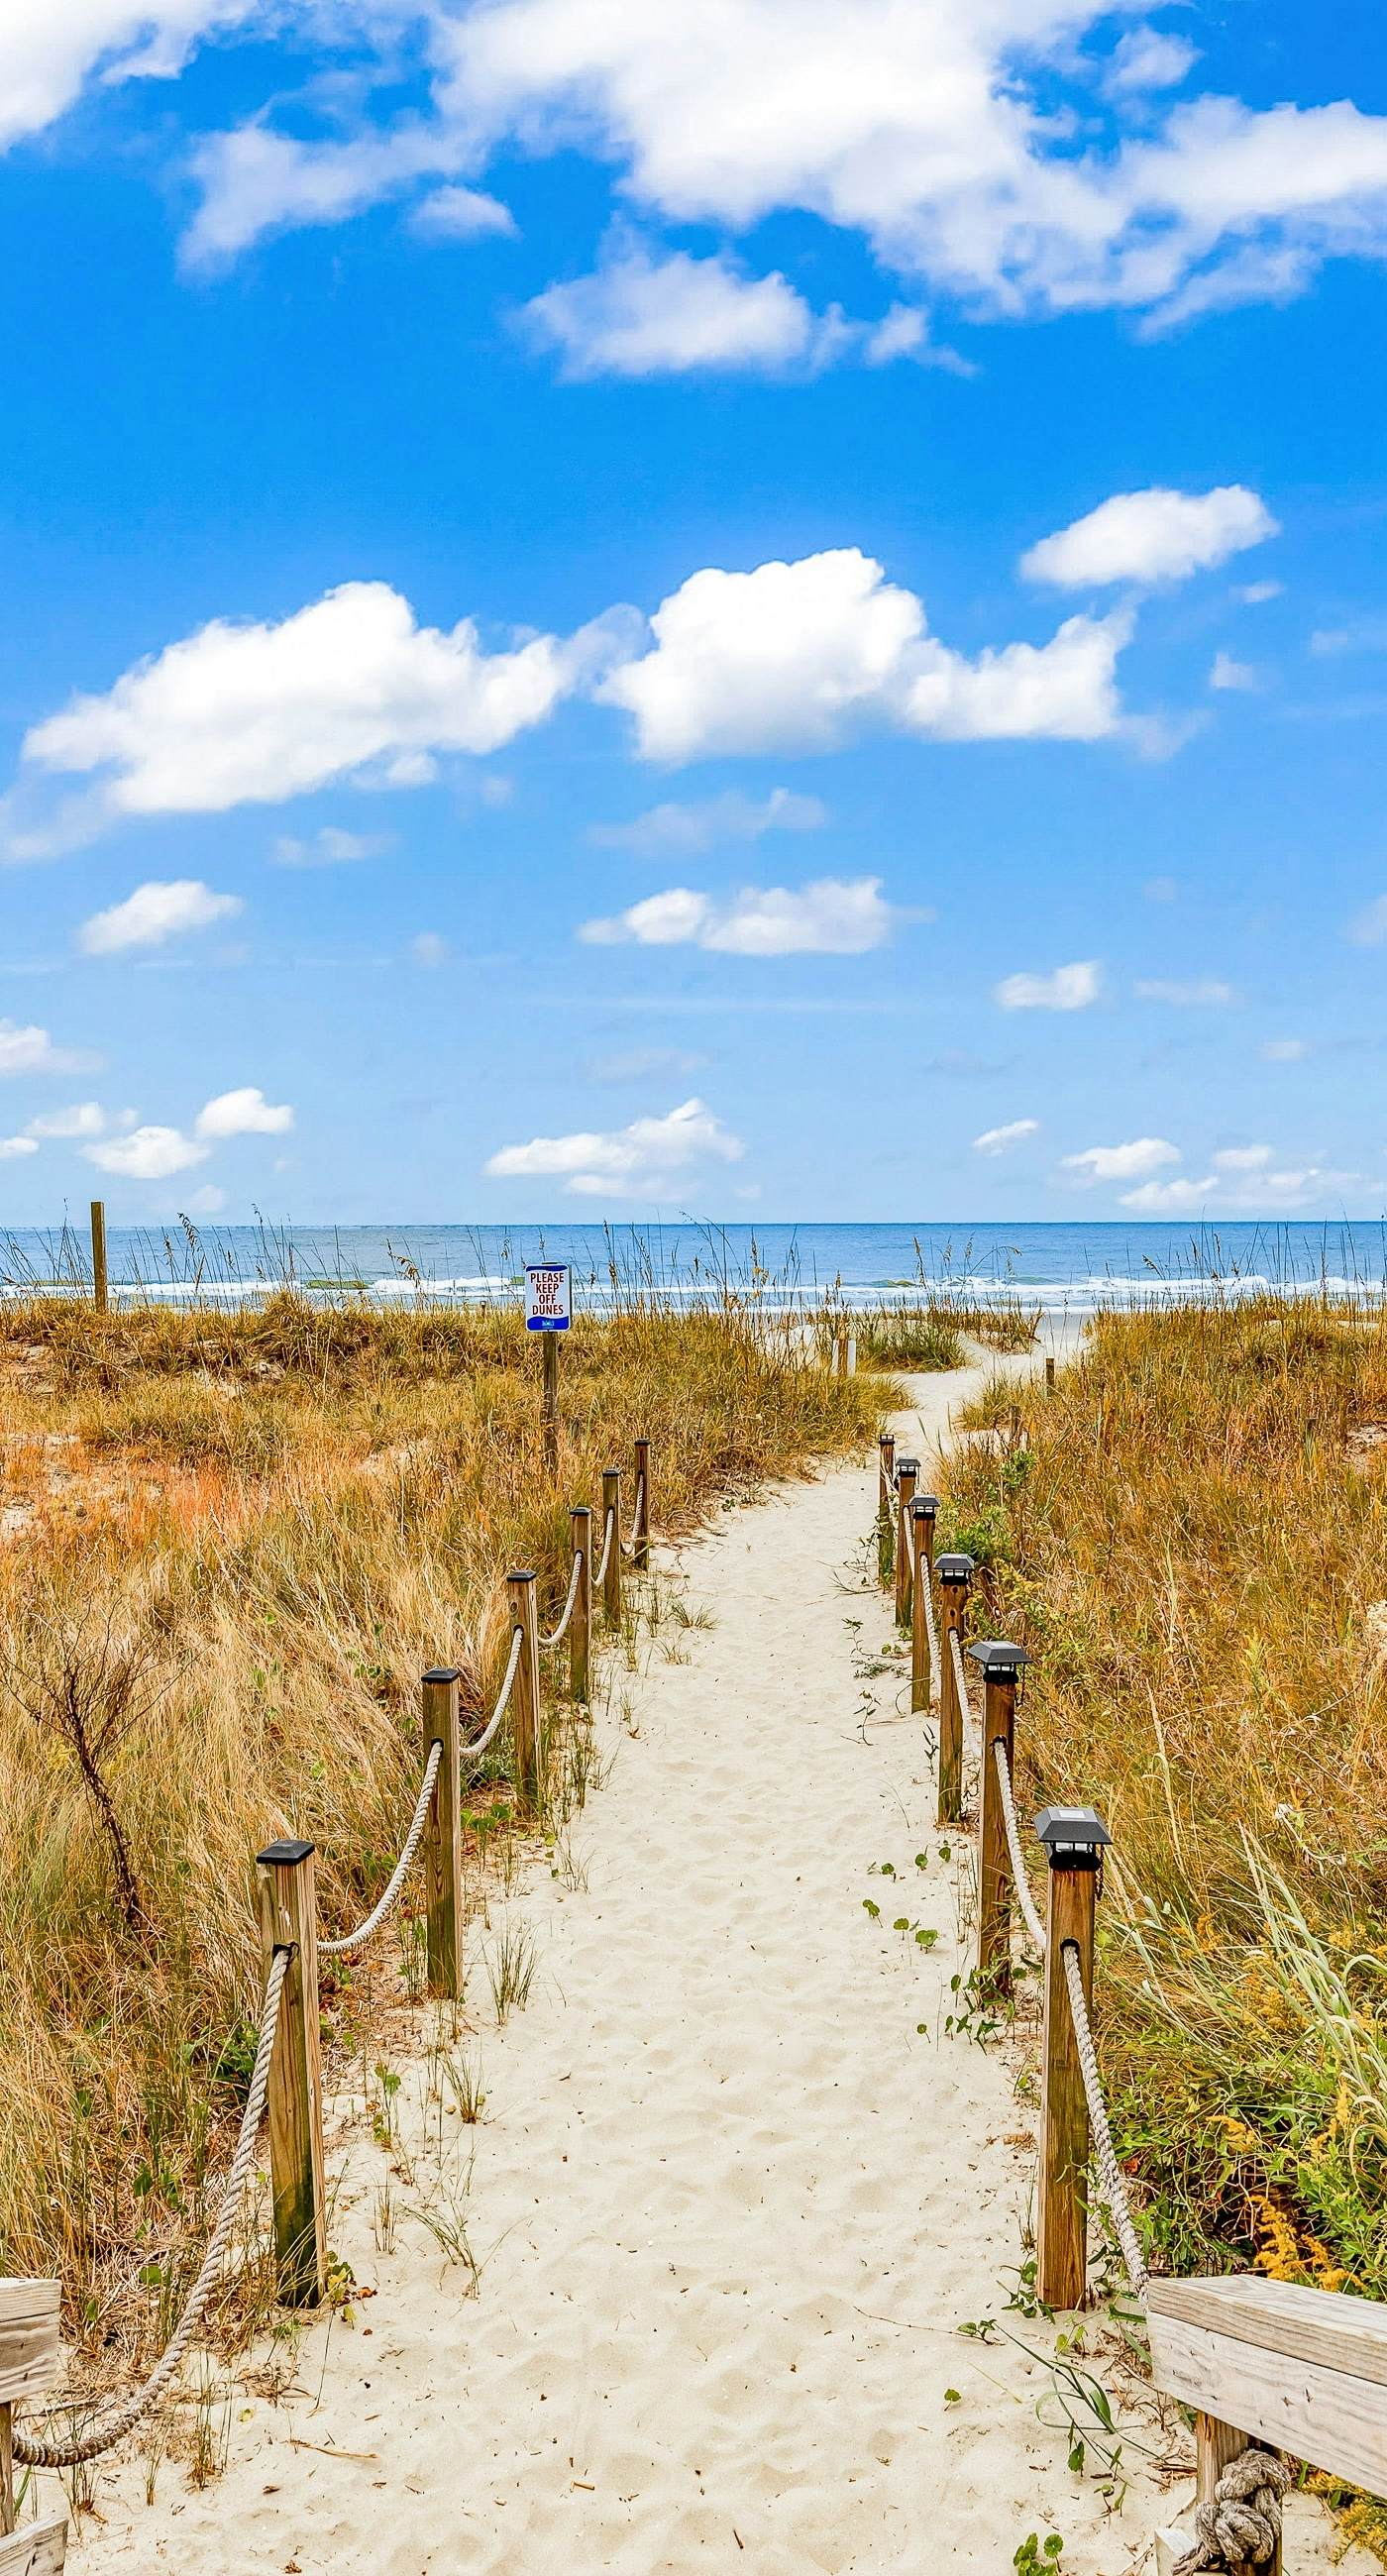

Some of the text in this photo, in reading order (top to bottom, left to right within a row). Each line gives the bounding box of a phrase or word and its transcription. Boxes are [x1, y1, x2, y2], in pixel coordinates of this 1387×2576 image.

[530, 1273, 565, 1283] PLEASE
[536, 1284, 560, 1293] KEEP
[539, 1294, 556, 1304] OFF
[532, 1305, 564, 1315] DUNES
